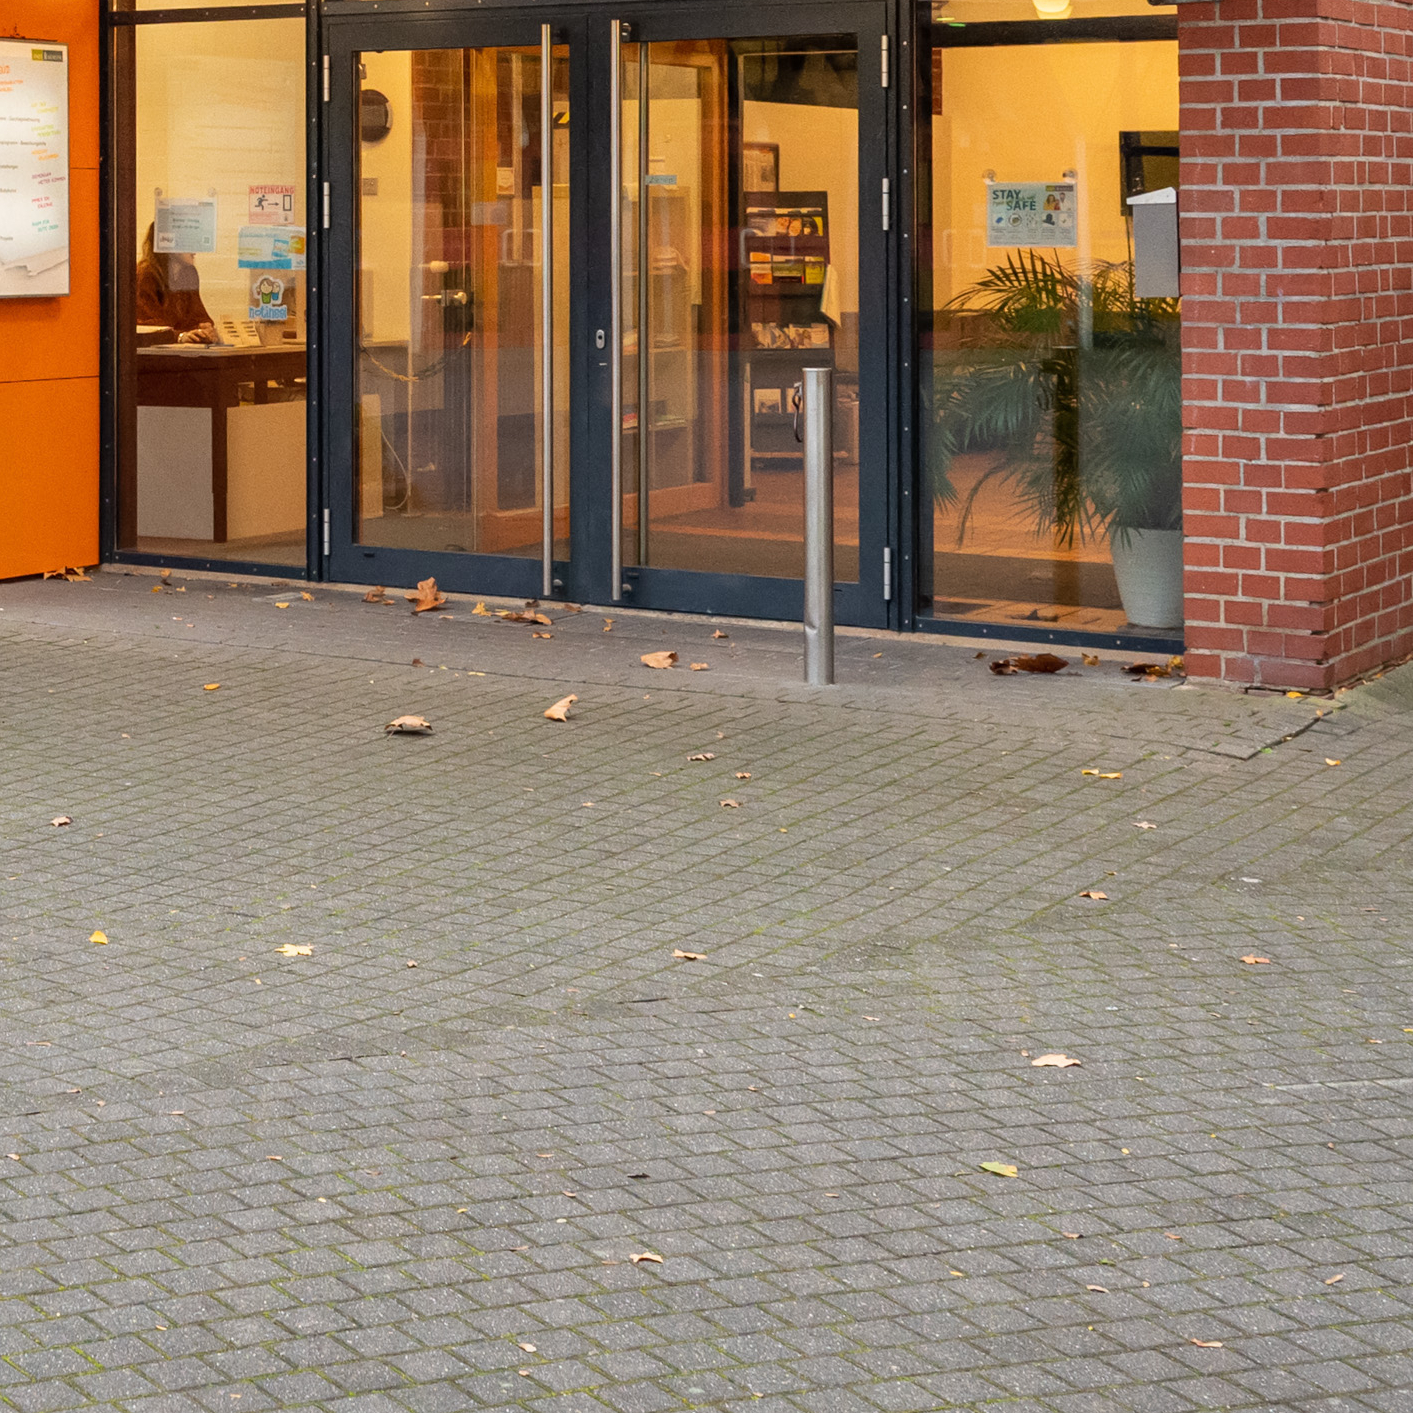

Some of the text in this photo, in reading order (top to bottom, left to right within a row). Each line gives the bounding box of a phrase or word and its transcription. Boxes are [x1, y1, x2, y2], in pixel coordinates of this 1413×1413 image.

[249, 186, 295, 195] NOTEINGANG
[992, 189, 1021, 200] STAY
[1006, 200, 1037, 211] SAFE
